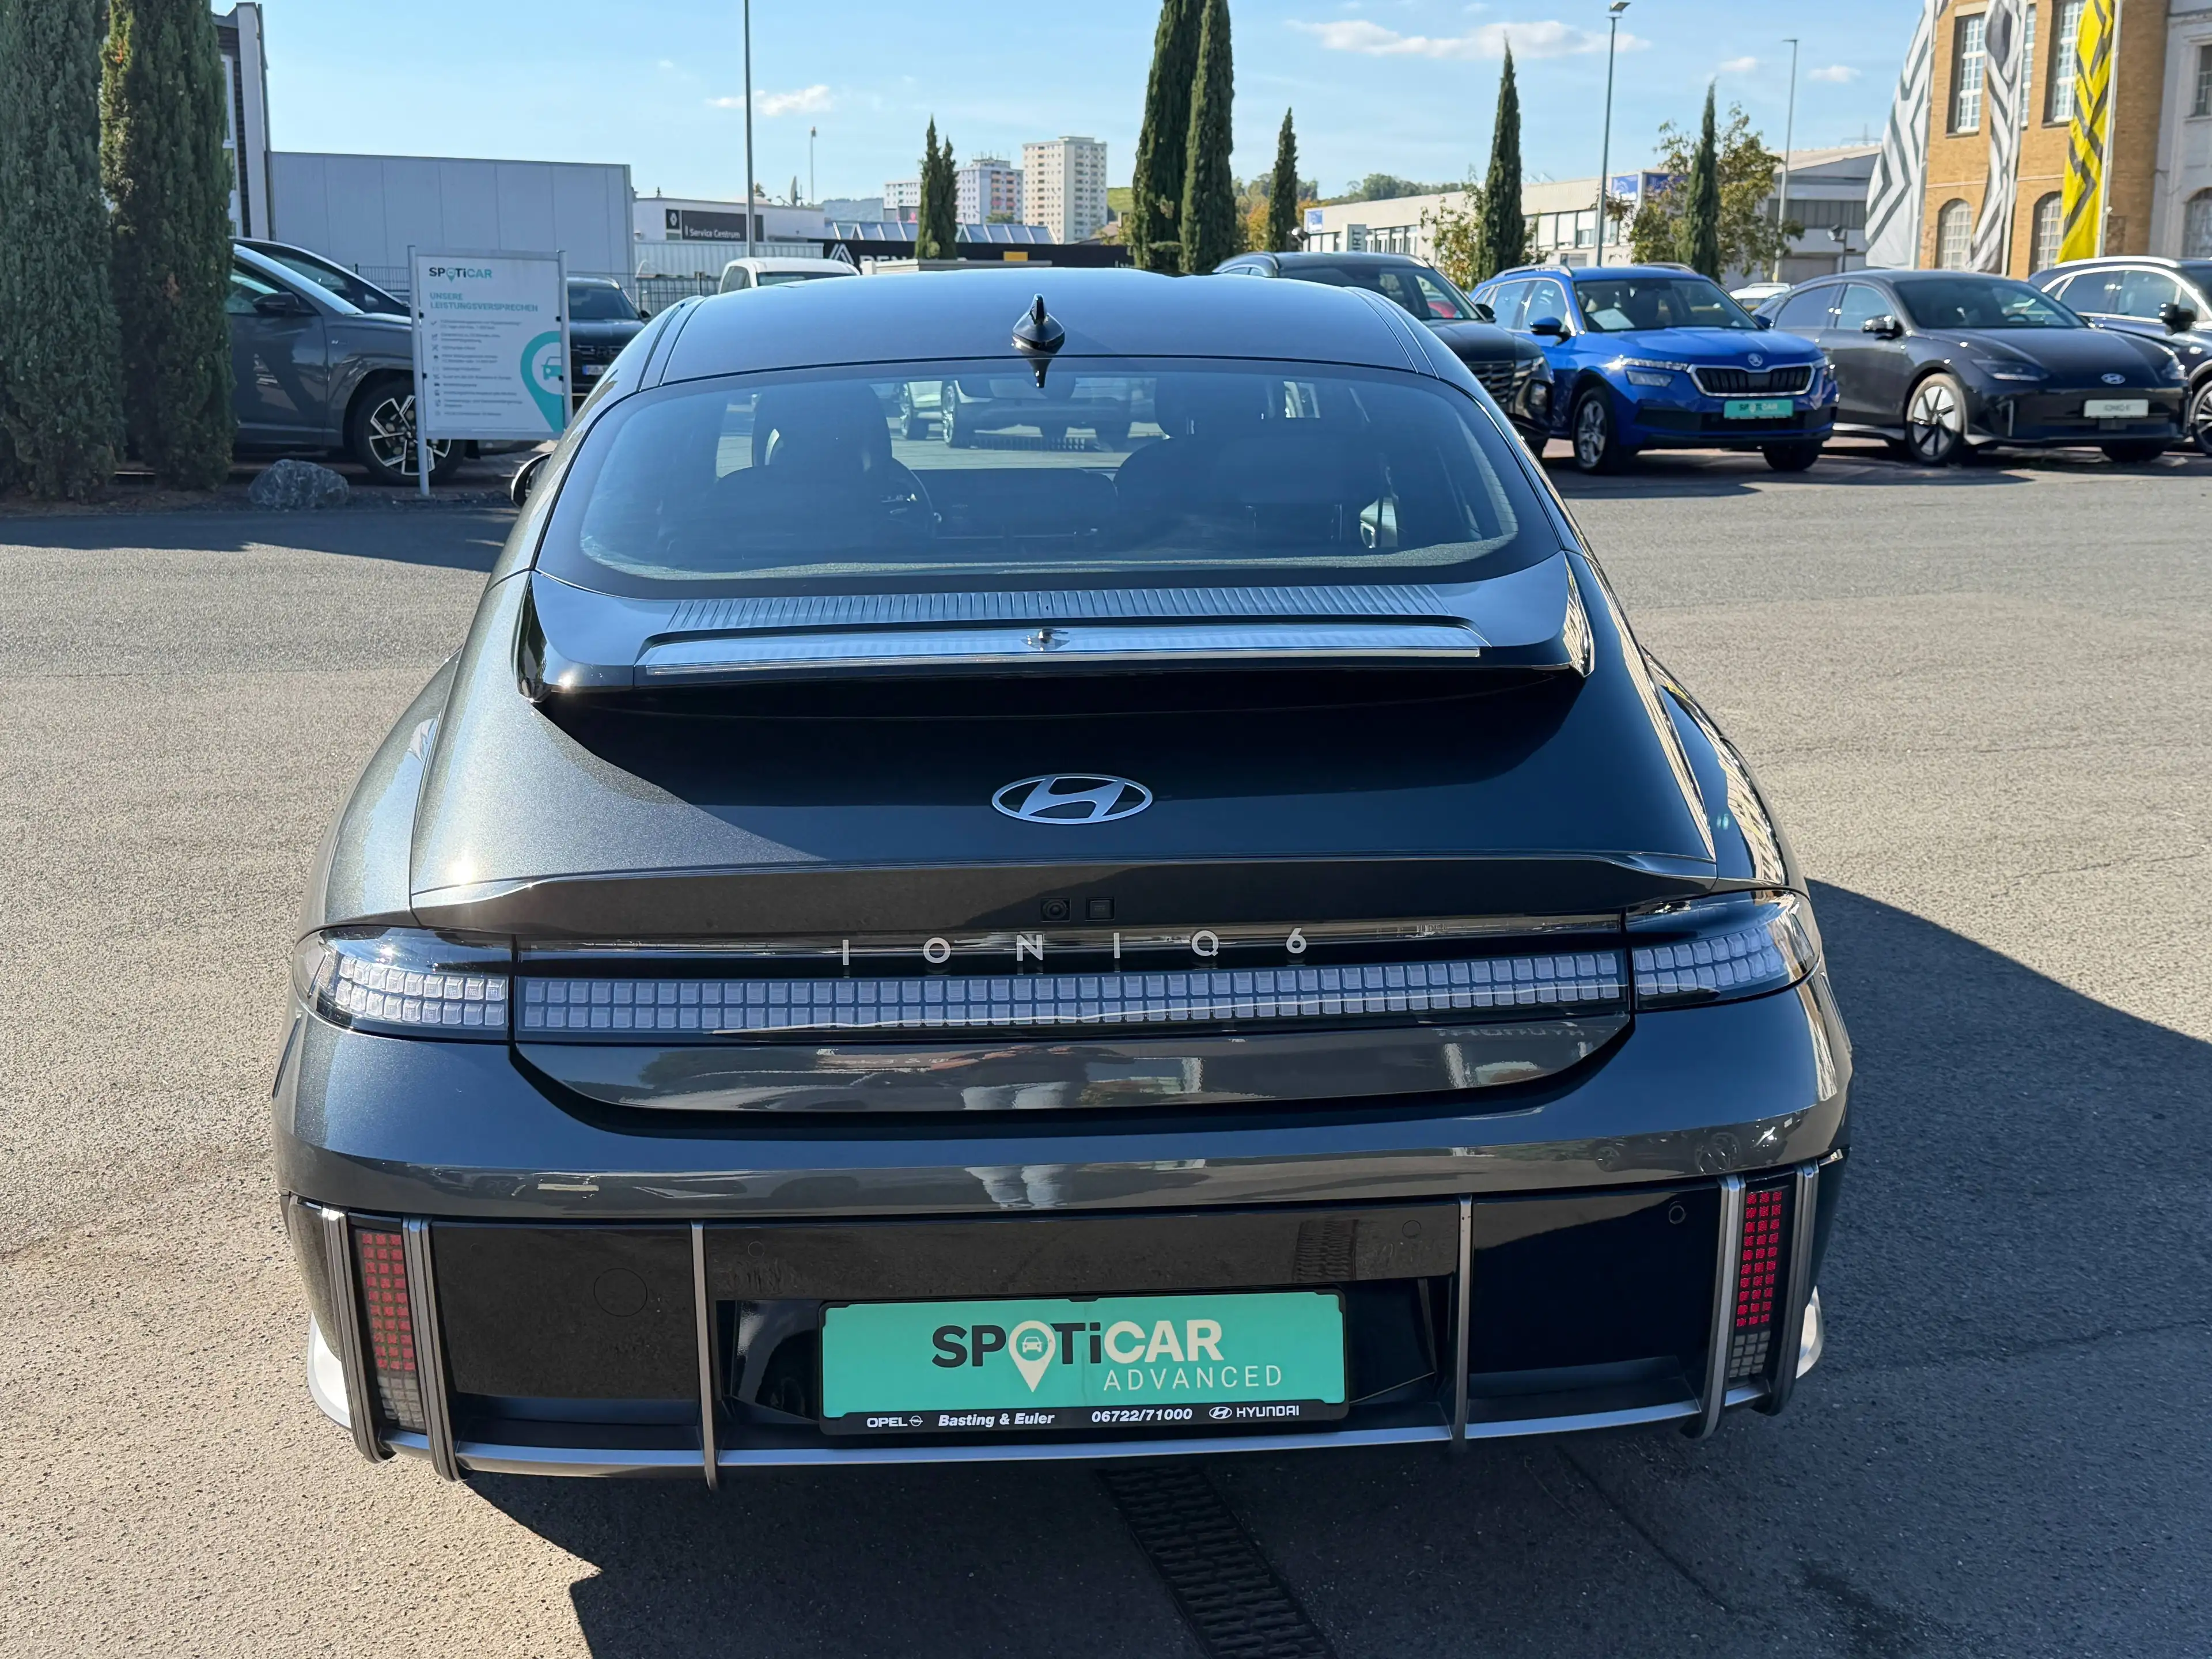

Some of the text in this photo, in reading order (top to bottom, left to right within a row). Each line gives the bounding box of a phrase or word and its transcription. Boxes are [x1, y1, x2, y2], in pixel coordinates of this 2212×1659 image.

[690, 229, 741, 239] Service Centrum
[430, 292, 464, 301] UNSERE
[430, 301, 538, 312] LEISTUNGSVERSPRECHEN
[842, 927, 1308, 966] IONIQ 6
[1103, 1365, 1282, 1391] ADVANCED
[866, 1405, 1300, 1428] OPEL Basting & Euler 06722/71000 HYUNDAI
